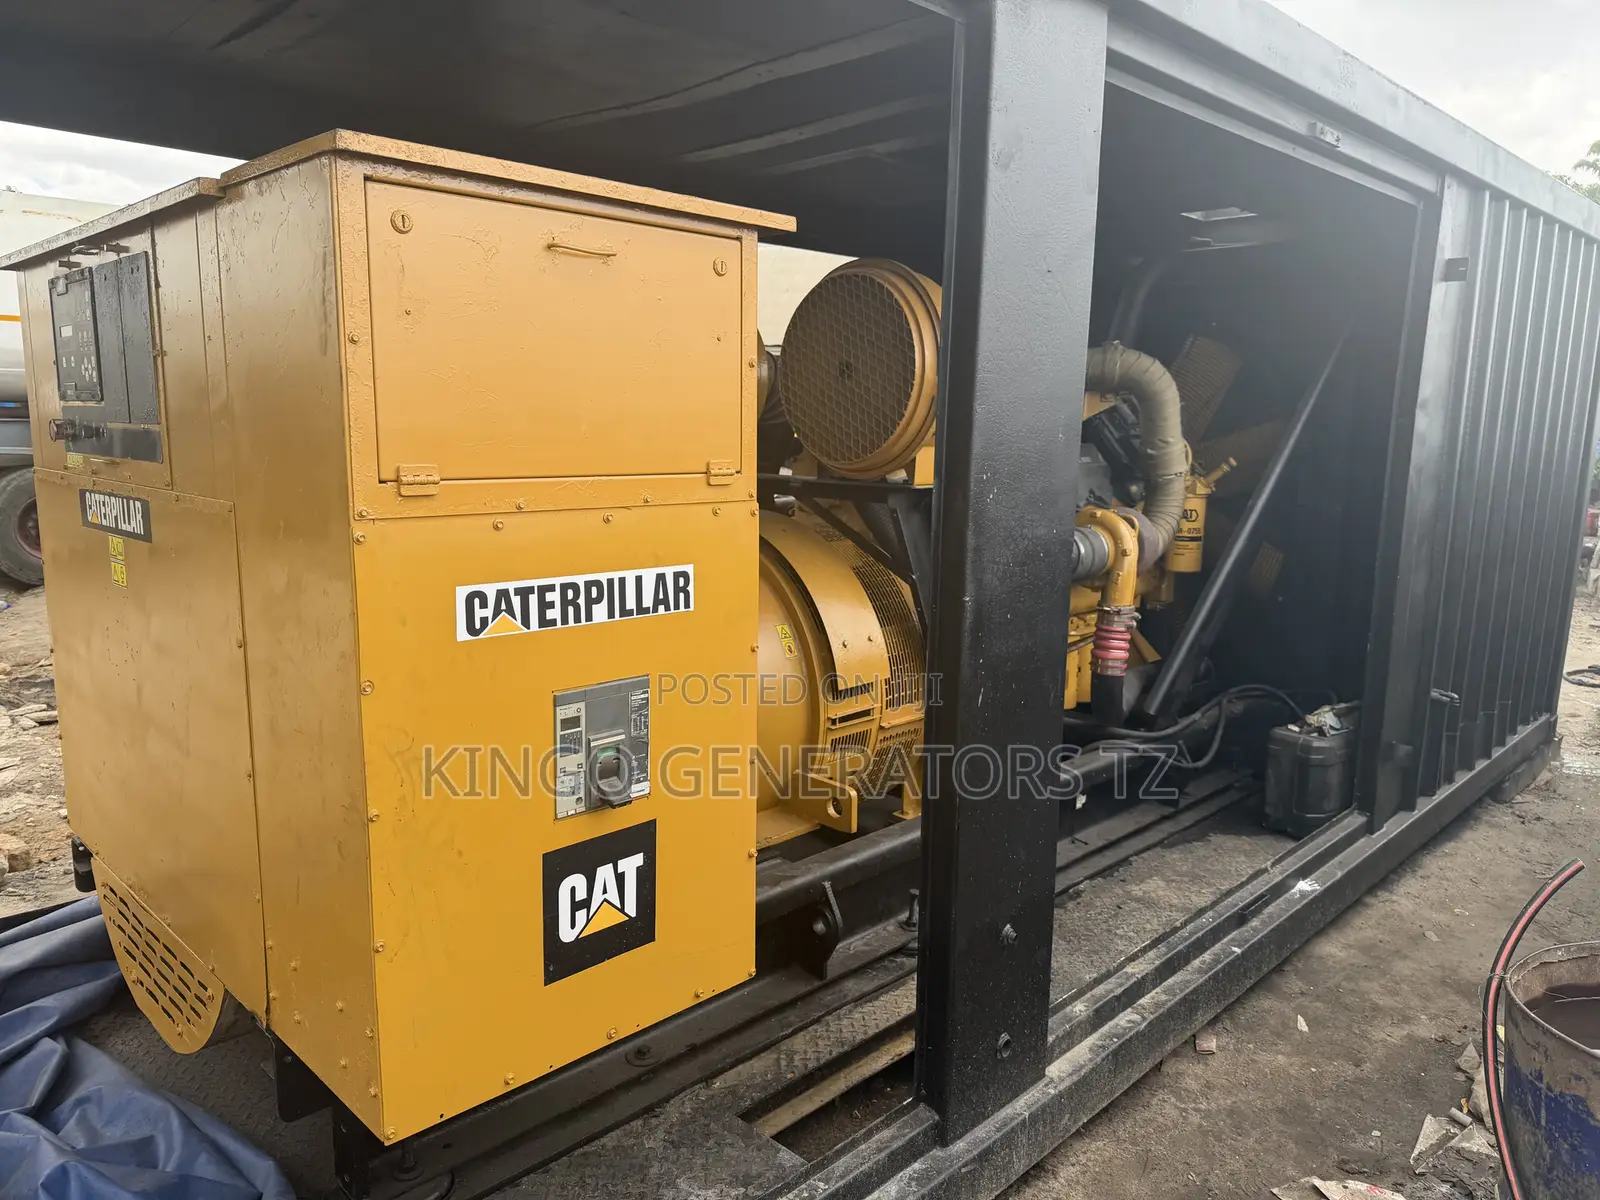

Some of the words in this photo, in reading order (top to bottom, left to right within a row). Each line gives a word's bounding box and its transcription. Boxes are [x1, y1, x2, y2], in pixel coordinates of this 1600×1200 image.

[85, 491, 144, 535] CATERPILLAR
[464, 570, 691, 638] CATERPILLAR
[558, 852, 644, 943] CAT
